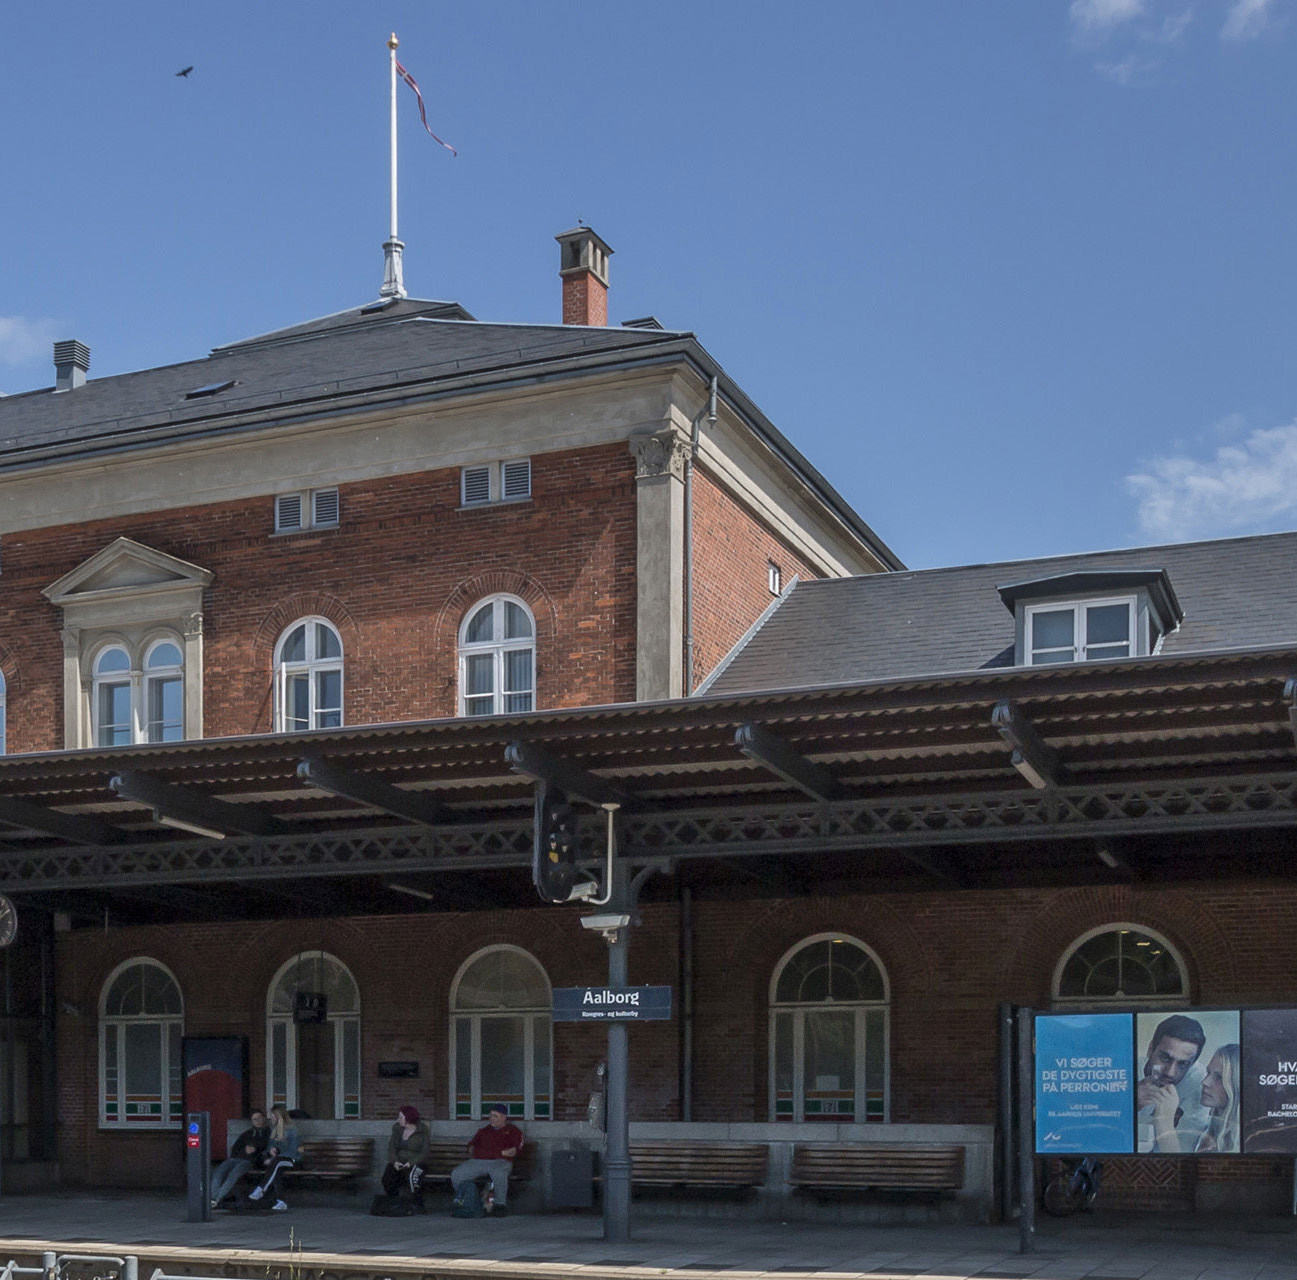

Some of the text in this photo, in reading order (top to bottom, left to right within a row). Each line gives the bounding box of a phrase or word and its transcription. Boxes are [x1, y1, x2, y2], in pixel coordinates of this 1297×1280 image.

[583, 990, 640, 1006] Aalborg
[1055, 1057, 1113, 1068] VI SØGER
[1042, 1069, 1127, 1081] DE DYGTIGSTE
[1042, 1081, 1058, 1093] PÅ
